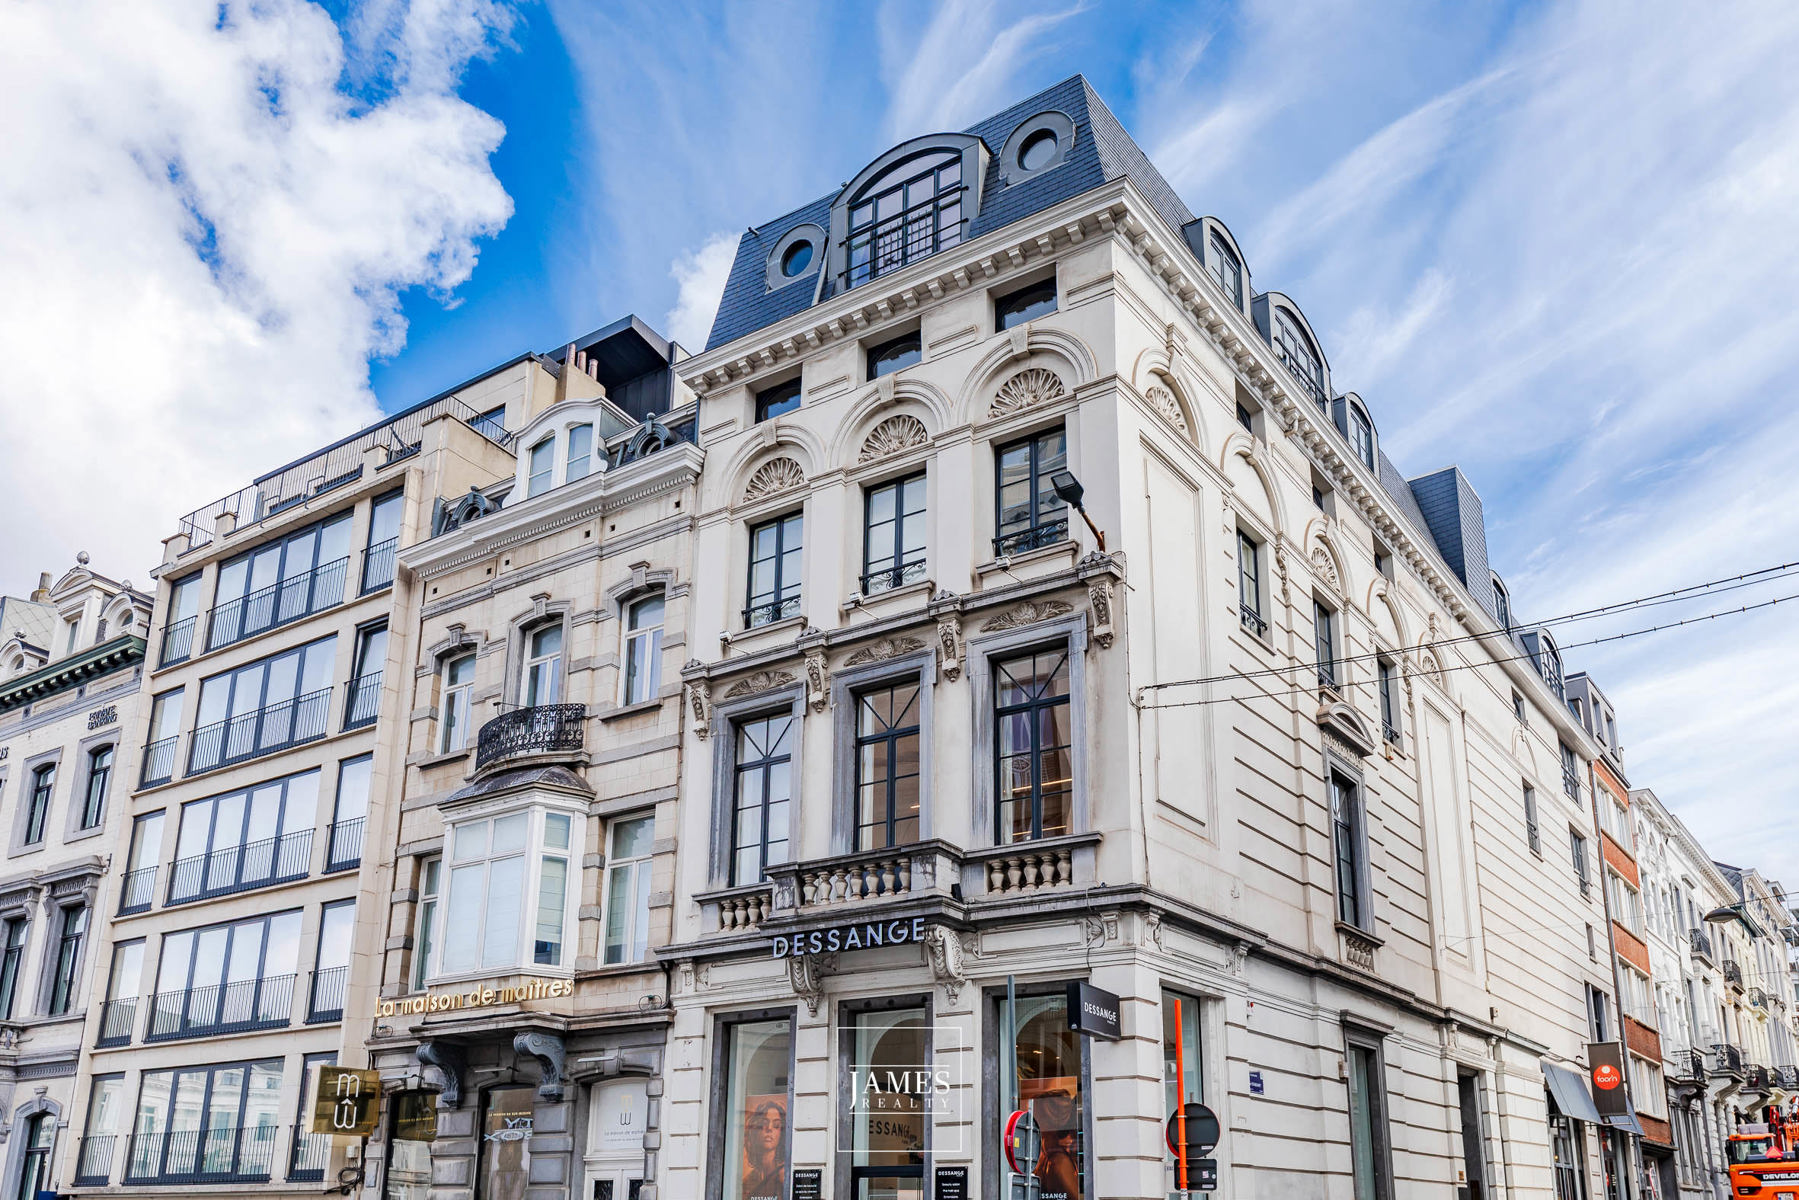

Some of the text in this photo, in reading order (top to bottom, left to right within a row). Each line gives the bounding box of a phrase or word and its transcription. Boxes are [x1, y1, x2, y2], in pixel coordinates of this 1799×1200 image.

[773, 917, 926, 959] DESSANGE
[375, 977, 575, 1018] La maison de maîtres
[1084, 1001, 1117, 1022] DESSANGE
